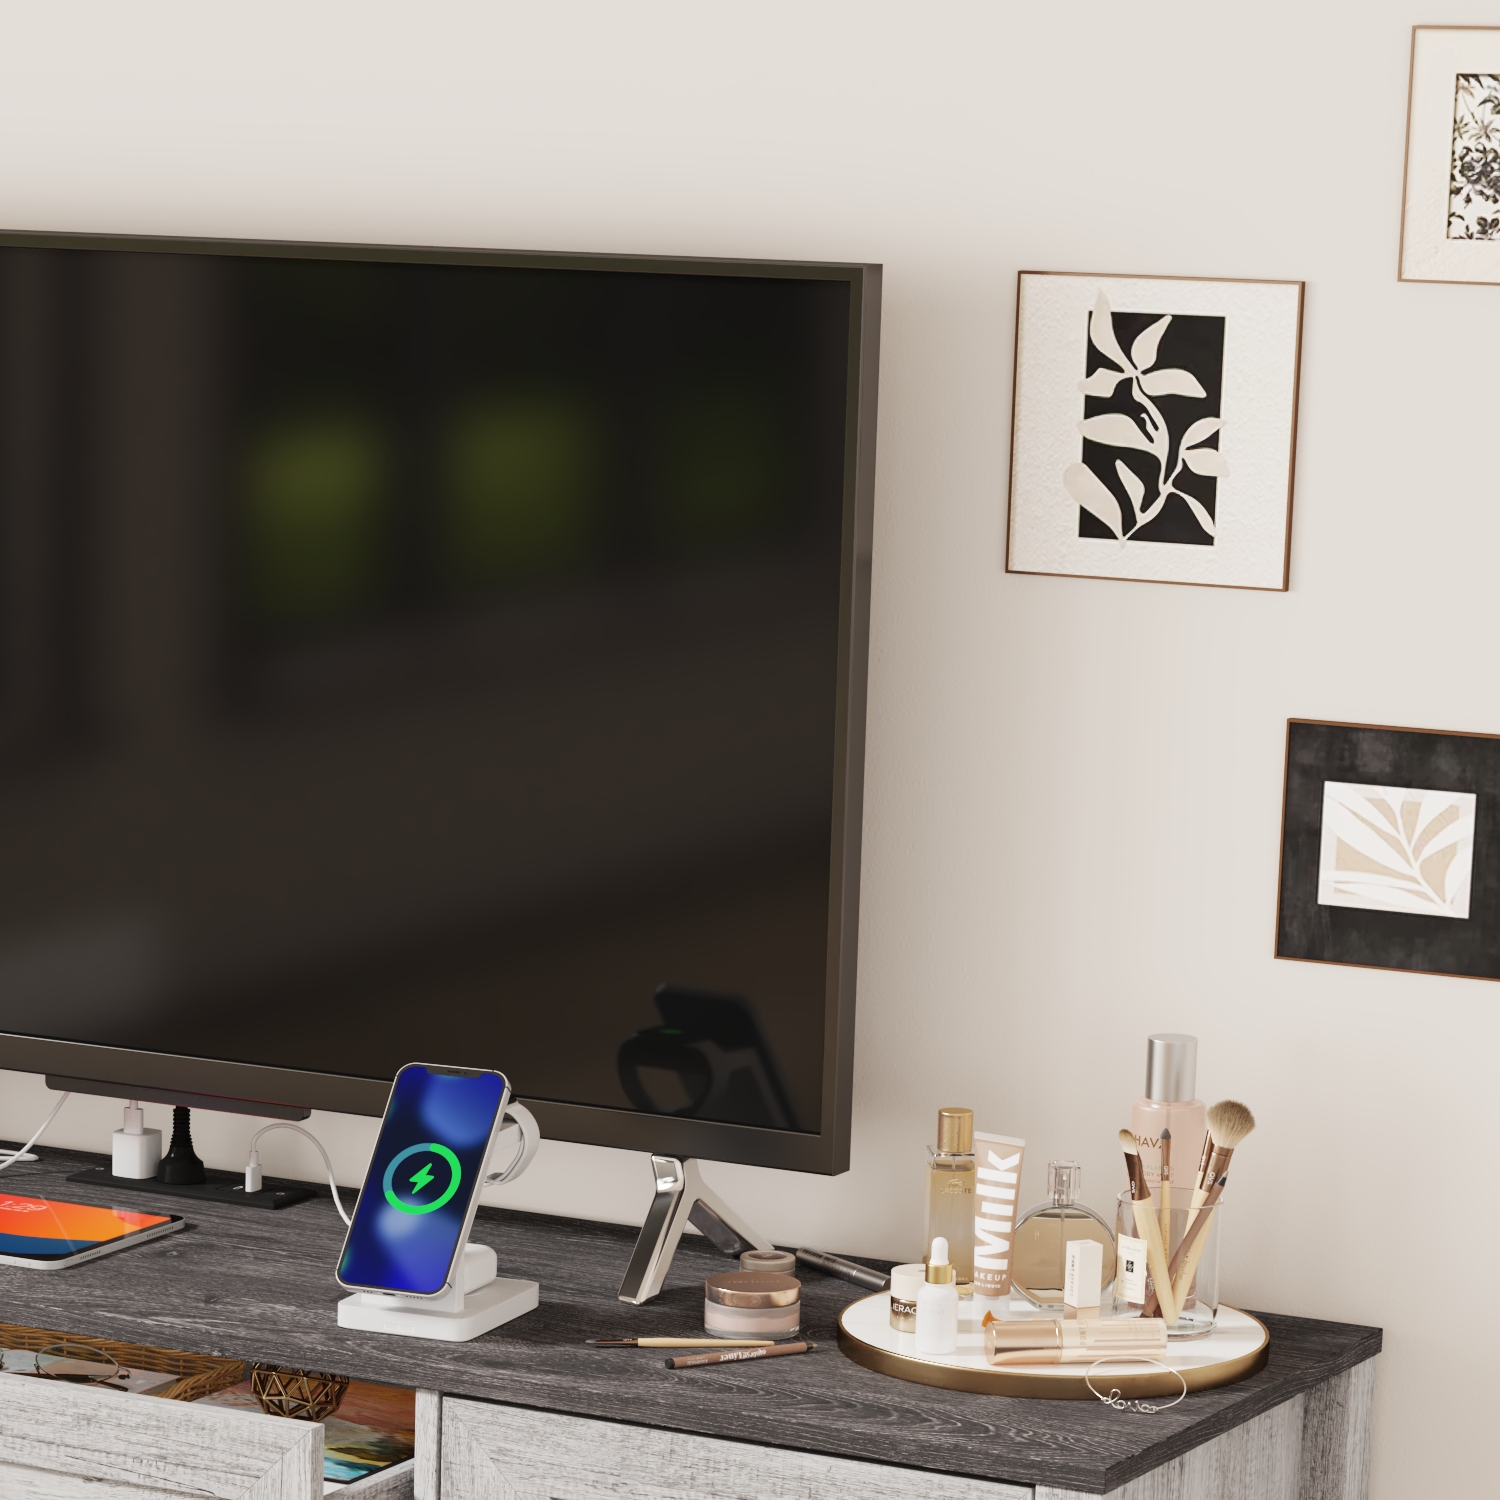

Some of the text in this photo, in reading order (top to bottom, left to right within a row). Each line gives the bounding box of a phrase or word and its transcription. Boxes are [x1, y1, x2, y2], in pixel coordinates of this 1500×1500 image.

[973, 1150, 1020, 1271] Milk
[974, 1270, 1007, 1282] AKEUP
[891, 1303, 916, 1315] IERAC
